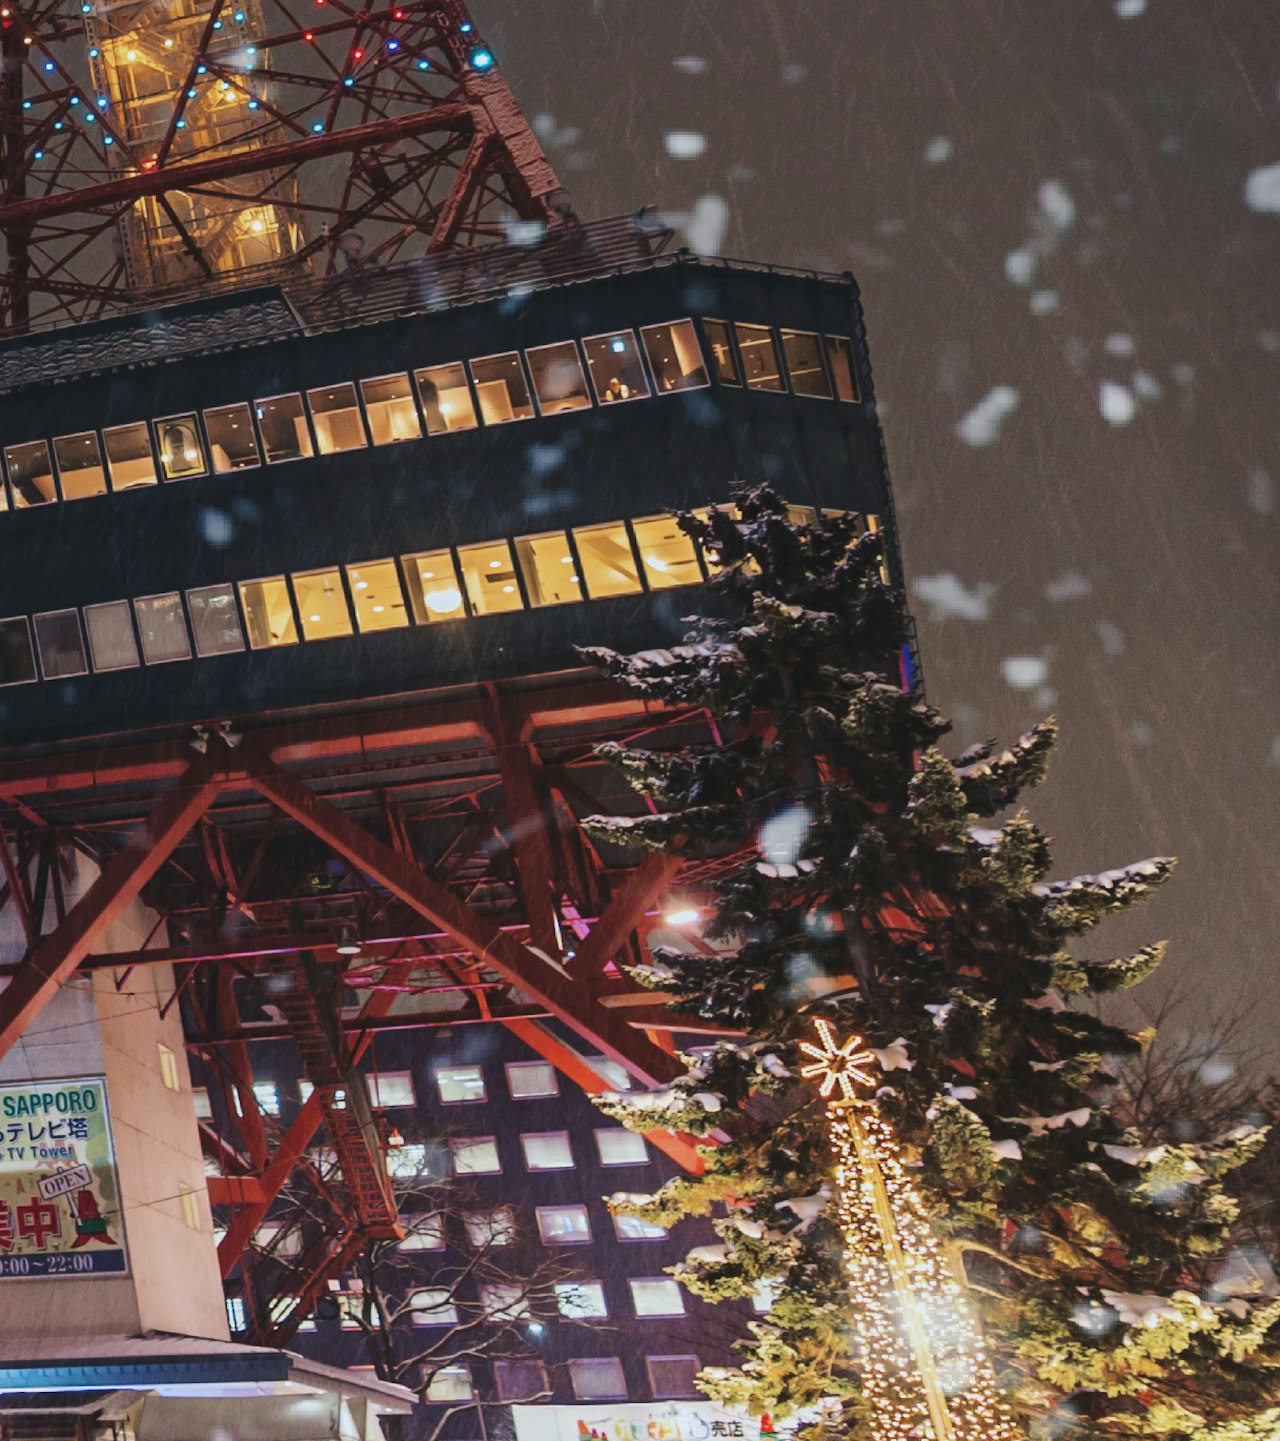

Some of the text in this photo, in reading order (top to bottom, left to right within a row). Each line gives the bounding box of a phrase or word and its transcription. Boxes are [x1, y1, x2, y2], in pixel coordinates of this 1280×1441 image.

[3, 1089, 97, 1118] SAPPORO
[8, 1147, 25, 1161] TV
[30, 1145, 73, 1159] Tower
[44, 1170, 86, 1195] OPEN
[711, 1420, 745, 1437] 売店
